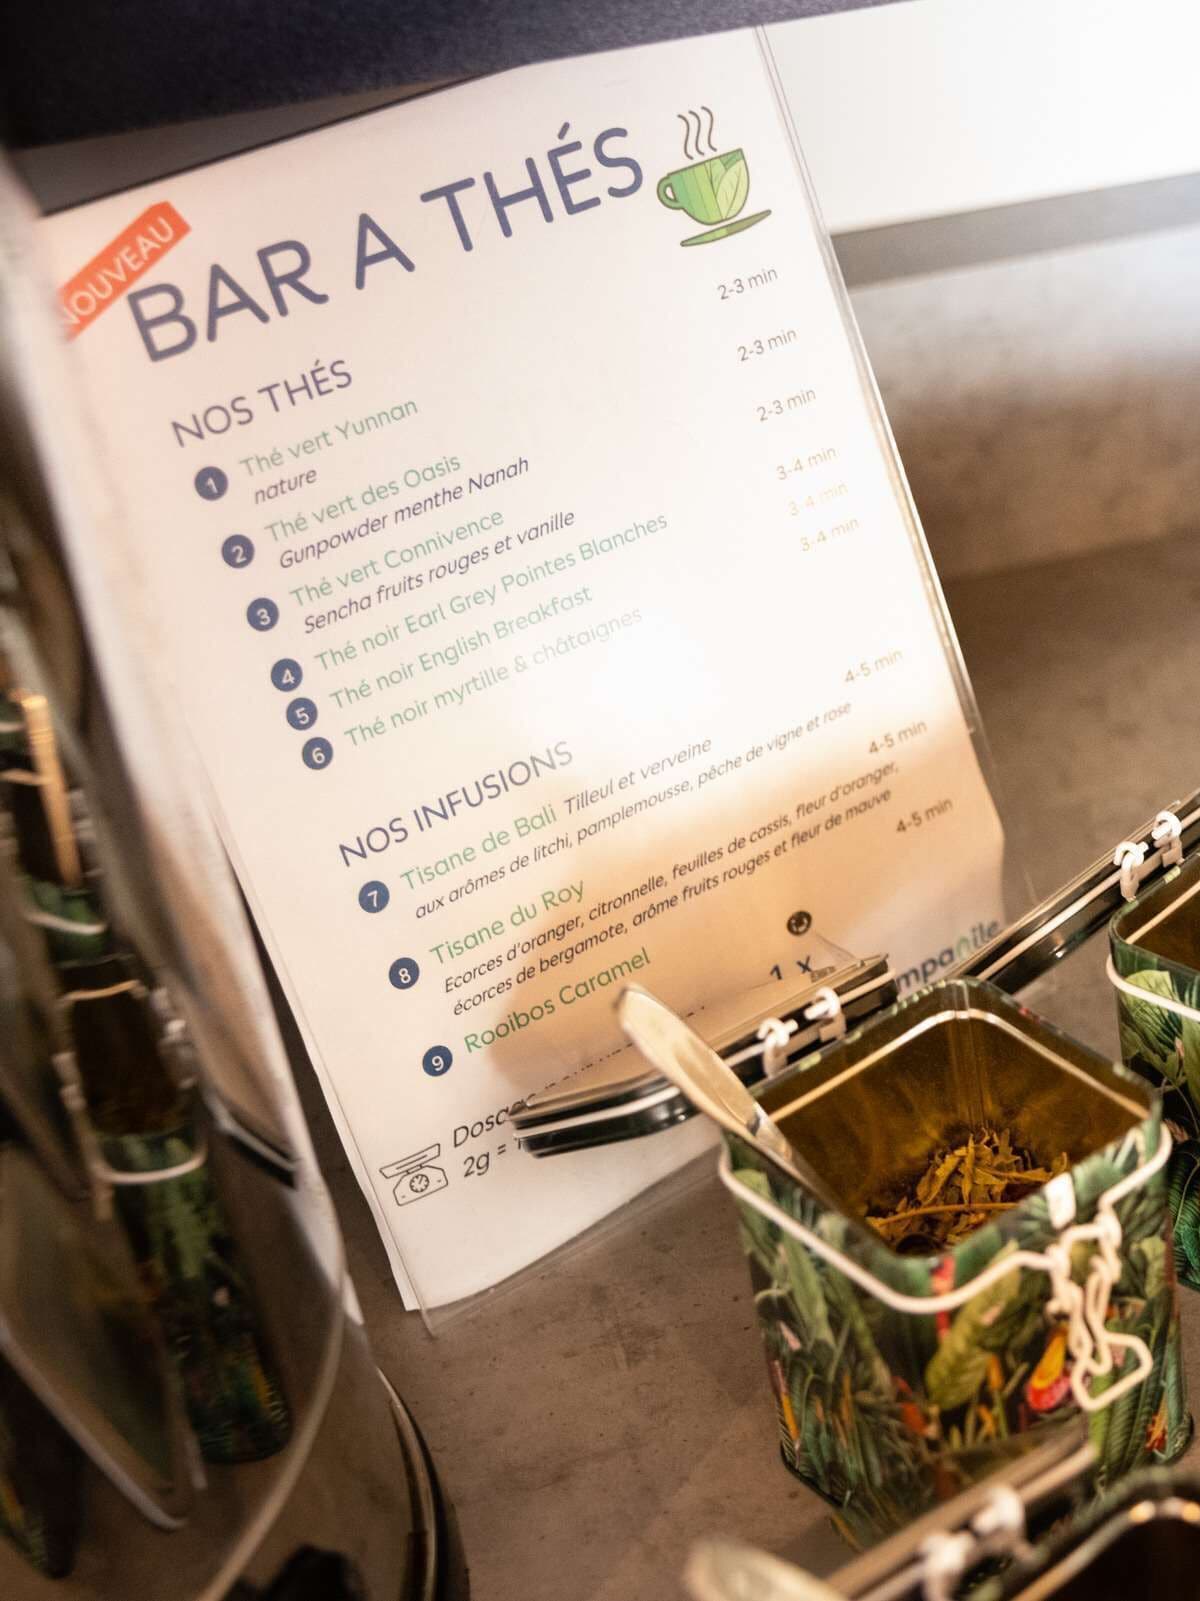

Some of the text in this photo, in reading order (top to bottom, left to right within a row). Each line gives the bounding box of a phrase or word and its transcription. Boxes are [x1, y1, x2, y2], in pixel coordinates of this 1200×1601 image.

[127, 122, 644, 362] BAR A THÉS
[717, 267, 778, 300] 2-3 min
[737, 328, 797, 362] 2-3 min
[171, 359, 352, 447] NOS THÉS
[240, 400, 418, 476] Thé vert Yunnan
[757, 387, 816, 422] 2-3 min
[254, 469, 317, 504] nature
[265, 454, 461, 542] Thé vert des Oasis
[776, 447, 836, 480] 3-4 min
[788, 495, 815, 516] 34
[280, 457, 529, 569] Gunpowder menthe Nanah
[290, 511, 505, 607] Thé vert Connivence
[304, 511, 575, 634] Sencha fruits rouges et vanille
[314, 513, 668, 671] Thé noir Earl Grey Pointes Blanches
[329, 586, 592, 709] Thé noir English Breakfast
[344, 607, 642, 747] Thé noir myrtille & châtaignes
[844, 649, 903, 684] 4-5 min
[868, 719, 928, 755] 4-5 min
[338, 741, 573, 867] NOS INFUSIONS
[400, 737, 712, 889] Tisane de Bali Tilleul et verveine
[415, 701, 852, 920] aux arômes de litchi, pamplemousse, pêche de vigne et rose
[895, 799, 953, 834] 4-5 min
[429, 880, 585, 966] Tisane du Roy
[444, 955, 503, 994] Ecorces
[588, 874, 668, 922] citronnelle,
[671, 842, 723, 882] feuilles
[727, 836, 746, 855] de
[749, 814, 793, 844] cassis,
[796, 796, 826, 819] fleur
[453, 789, 891, 1016] écorces de bergamote, arôme fruits rouges et fleur de mauve
[897, 920, 999, 991] mpanile
[463, 947, 652, 1054] Rooibos Caramel
[463, 1152, 490, 1178] 2g
